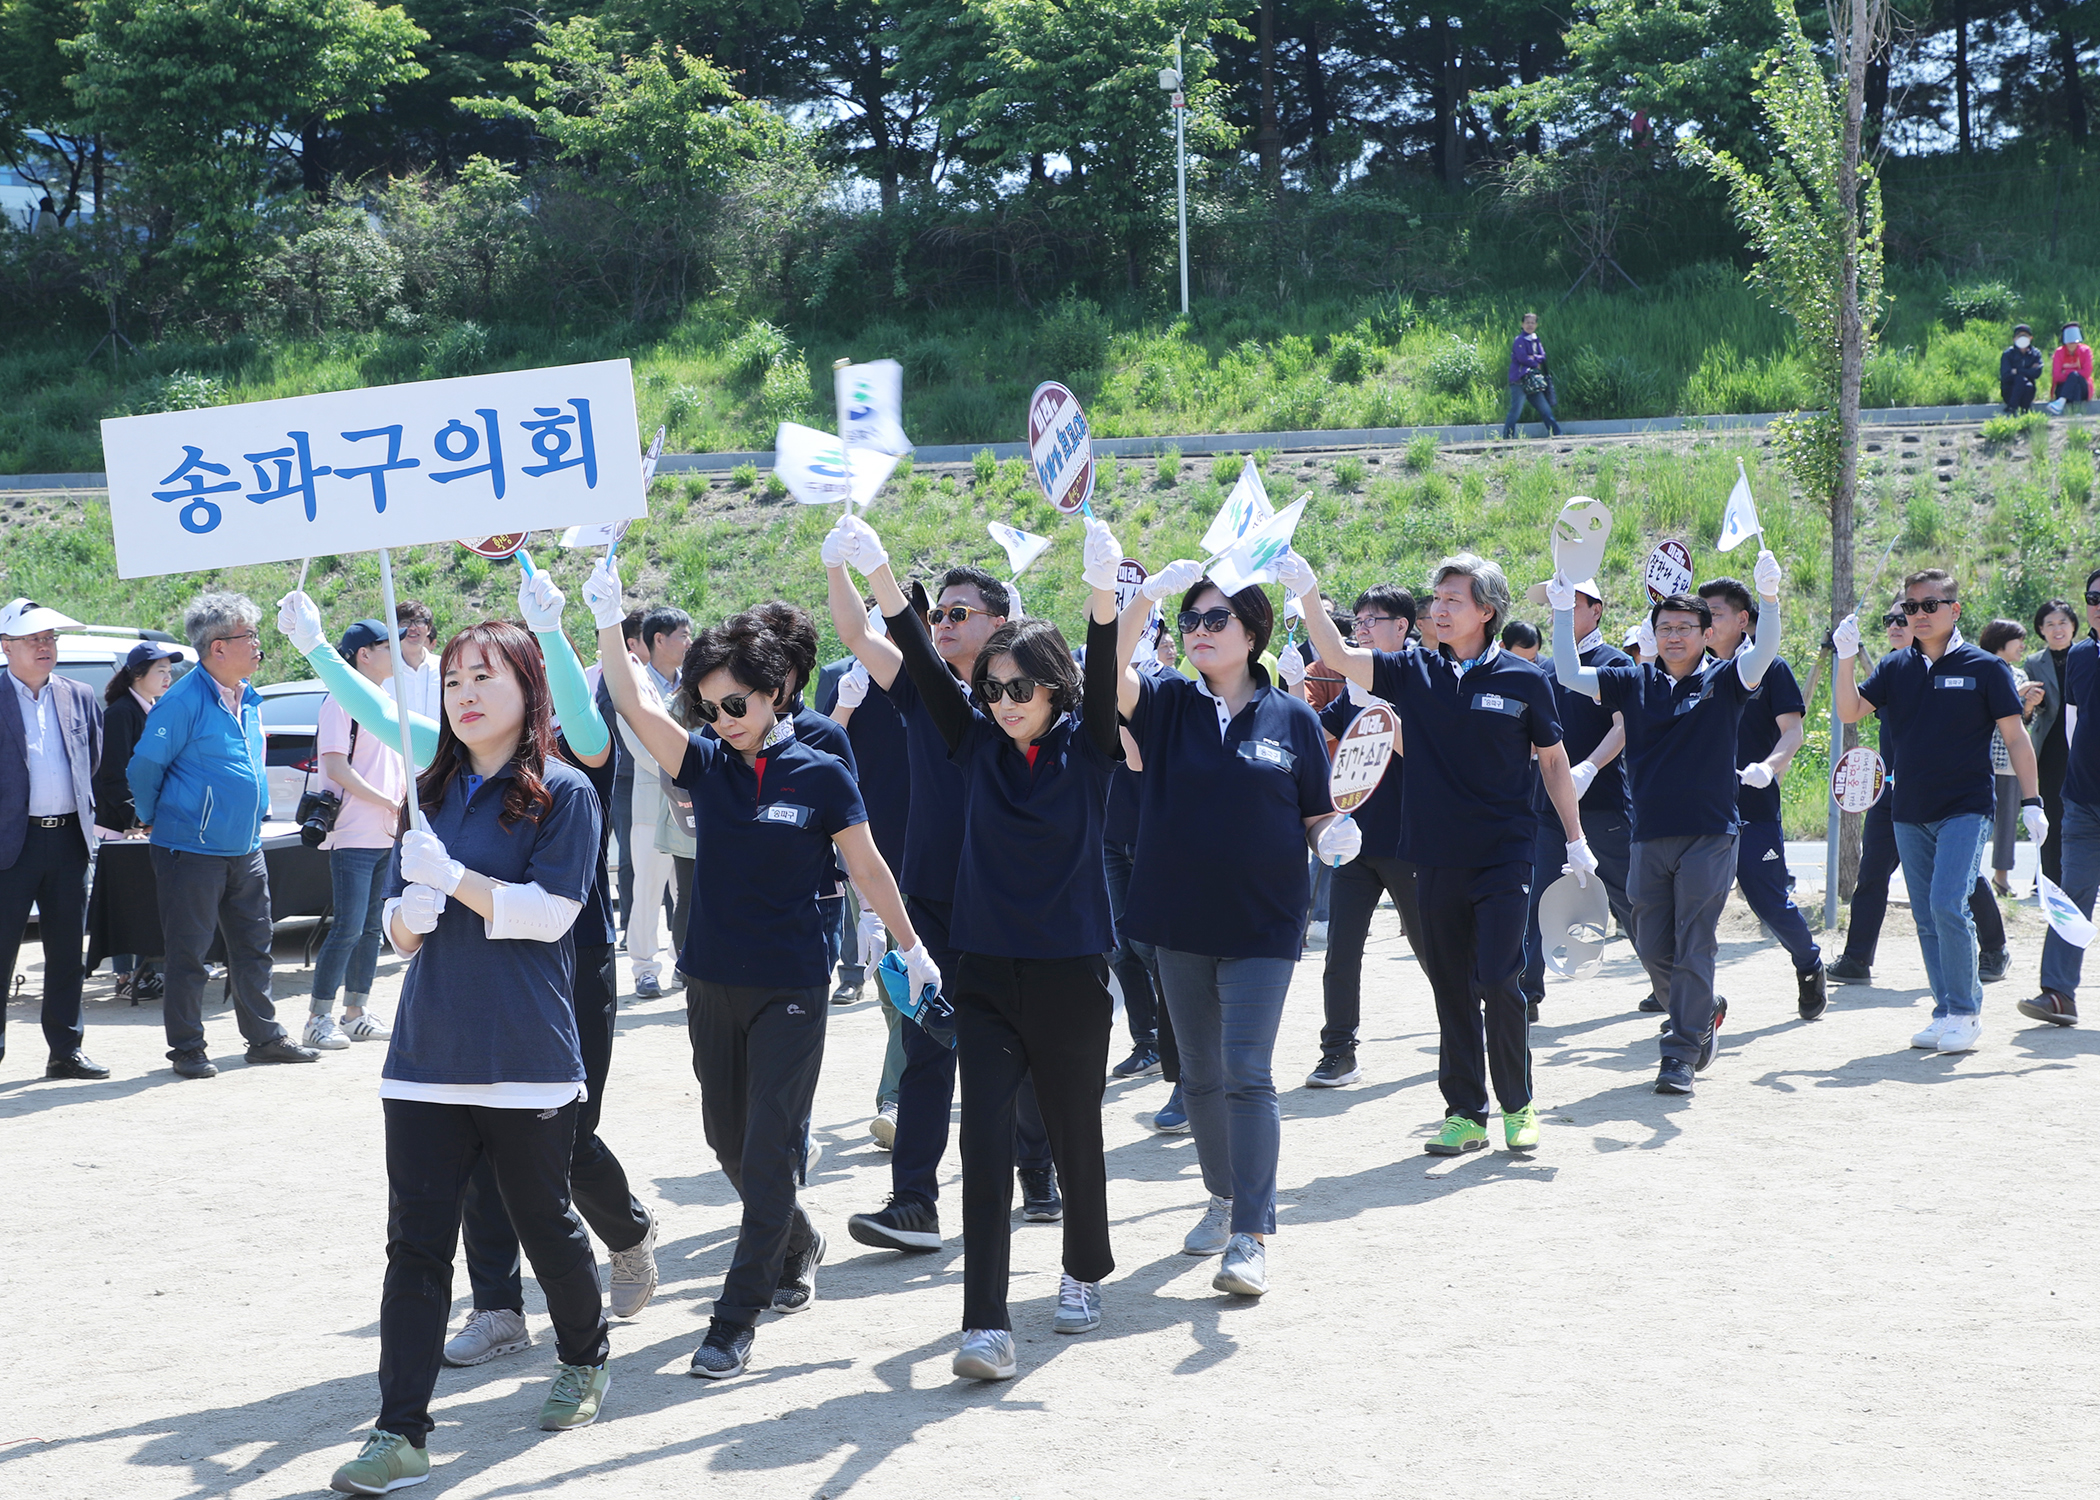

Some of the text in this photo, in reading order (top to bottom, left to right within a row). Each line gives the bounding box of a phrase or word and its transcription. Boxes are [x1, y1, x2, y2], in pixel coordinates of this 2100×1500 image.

[1056, 411, 1087, 462] 최고야
[151, 398, 597, 534] 송파구의회
[1648, 554, 1689, 594] 잘한다 송파
[1362, 742, 1391, 781] 송파
[774, 809, 795, 819] 송파구
